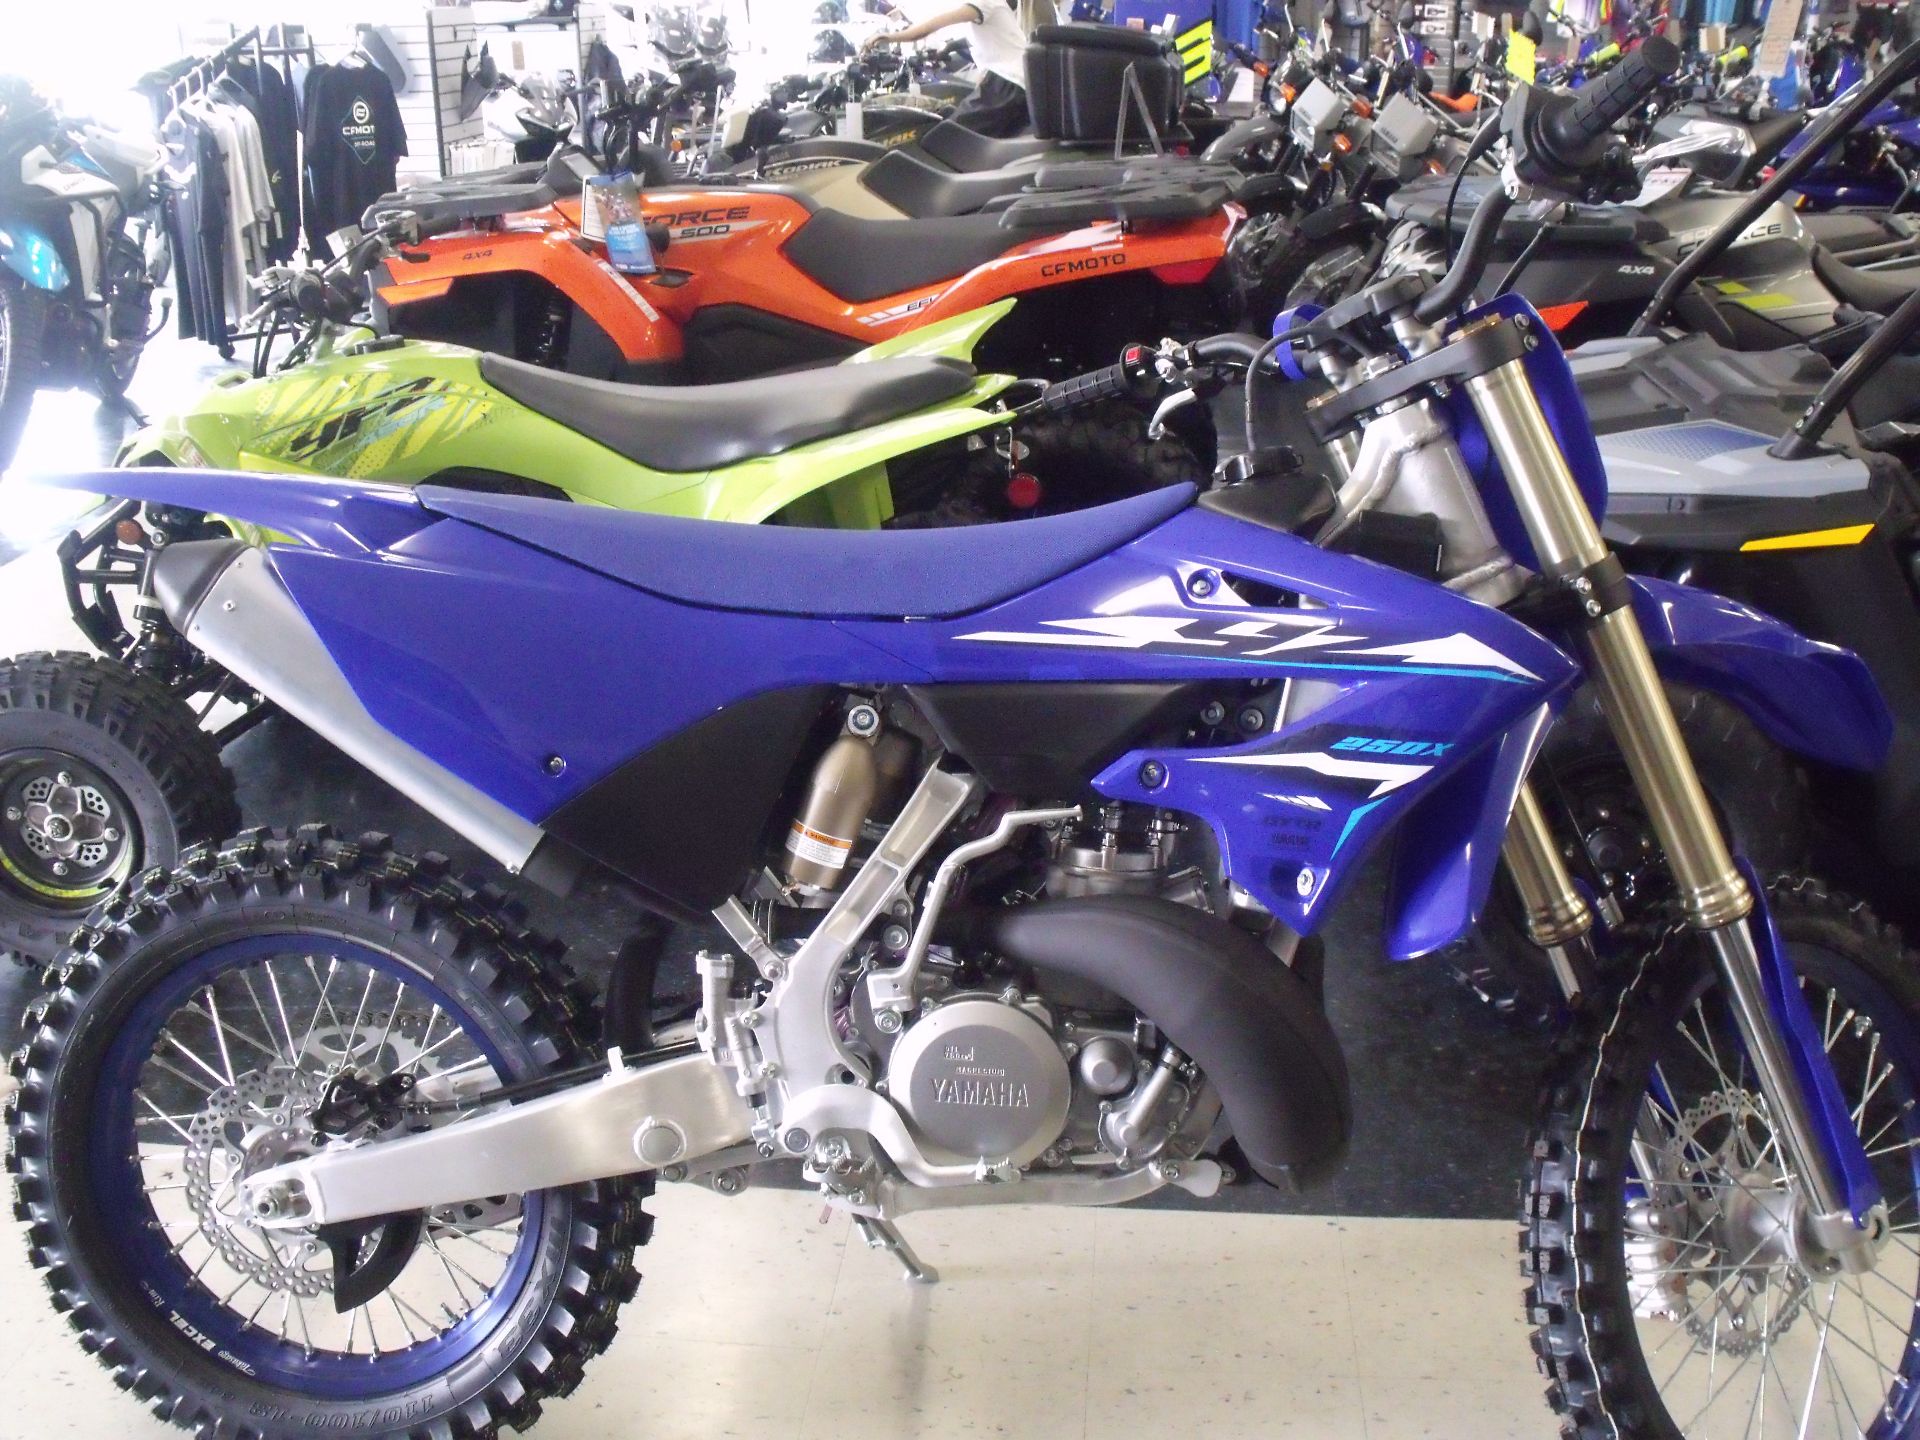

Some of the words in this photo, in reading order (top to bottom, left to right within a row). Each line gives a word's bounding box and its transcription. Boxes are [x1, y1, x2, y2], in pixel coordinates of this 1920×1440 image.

[342, 125, 375, 135] CFMOT
[681, 224, 731, 239] 500
[1041, 253, 1127, 277] CFMOTO
[1330, 736, 1455, 757] 250X
[955, 1066, 1005, 1077] MAGNESIUM
[930, 1078, 1029, 1108] YAMAHA
[169, 1310, 217, 1352] EXCEL
